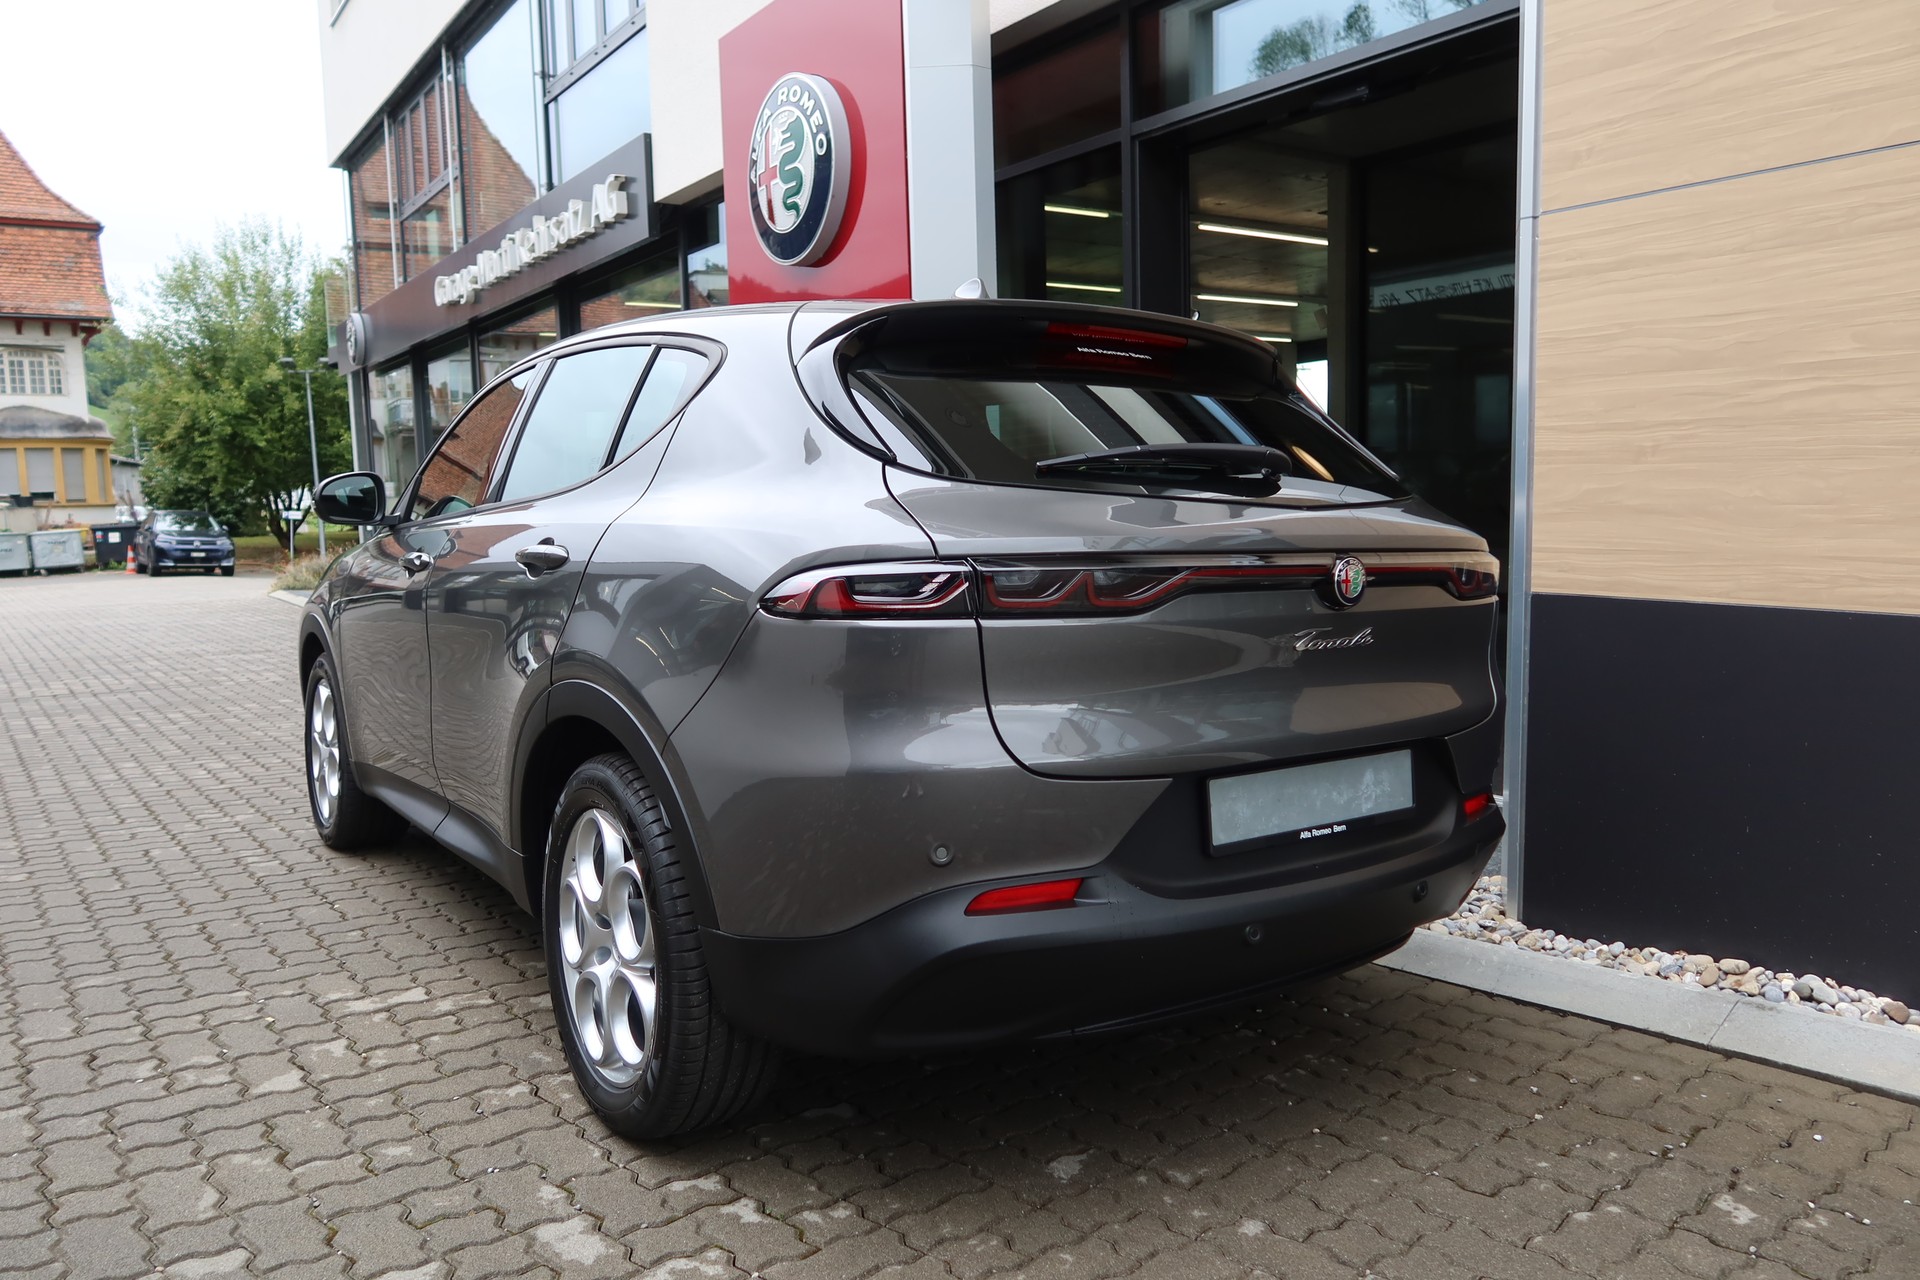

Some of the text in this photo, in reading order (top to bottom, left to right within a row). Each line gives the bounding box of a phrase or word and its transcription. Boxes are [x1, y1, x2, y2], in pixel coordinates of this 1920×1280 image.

[751, 85, 827, 184] ALFA ROMEO
[591, 174, 628, 228] AG
[1096, 349, 1129, 357] Romeo
[1300, 831, 1311, 839] Alfa
[1312, 828, 1332, 836] Romeo
